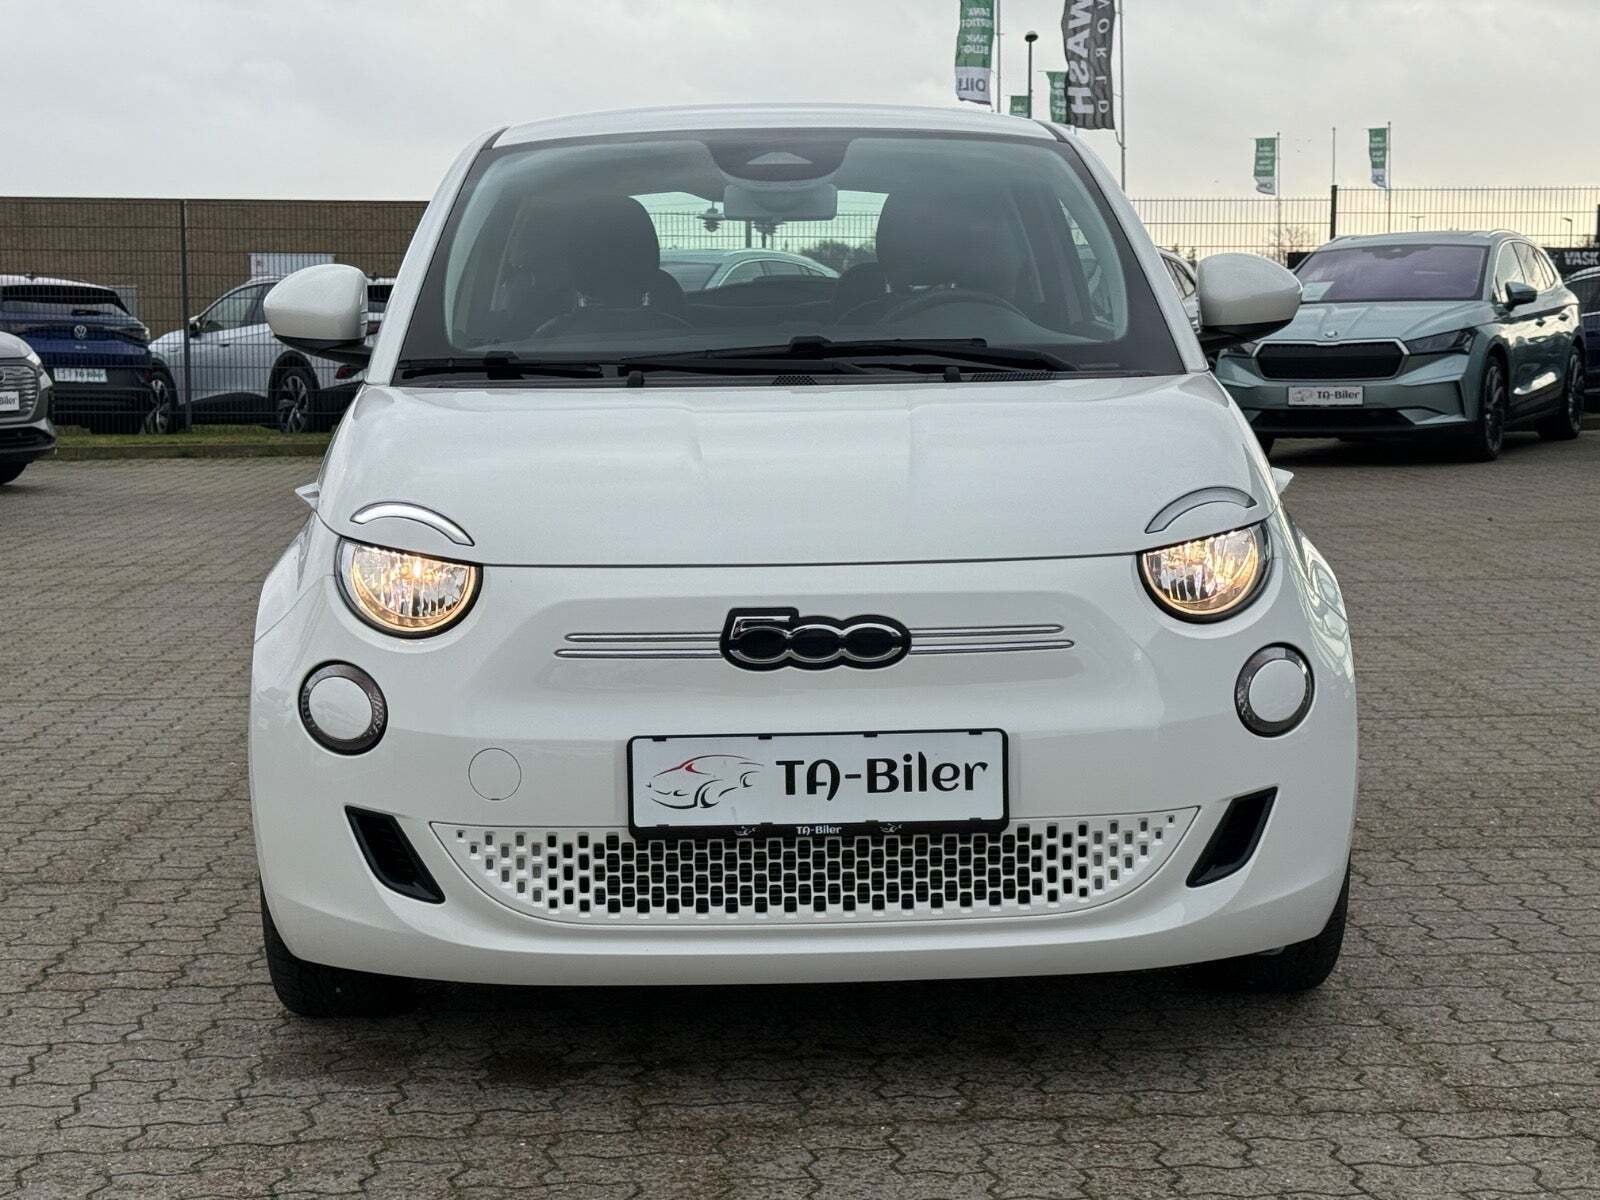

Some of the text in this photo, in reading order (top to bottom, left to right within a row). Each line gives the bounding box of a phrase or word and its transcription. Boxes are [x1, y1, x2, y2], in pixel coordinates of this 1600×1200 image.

[1565, 251, 1599, 265] VASK
[1317, 390, 1360, 401] TA-Biler
[723, 609, 909, 670] 500
[775, 751, 989, 801] TA-Biler
[796, 824, 842, 837] TA-Biler
